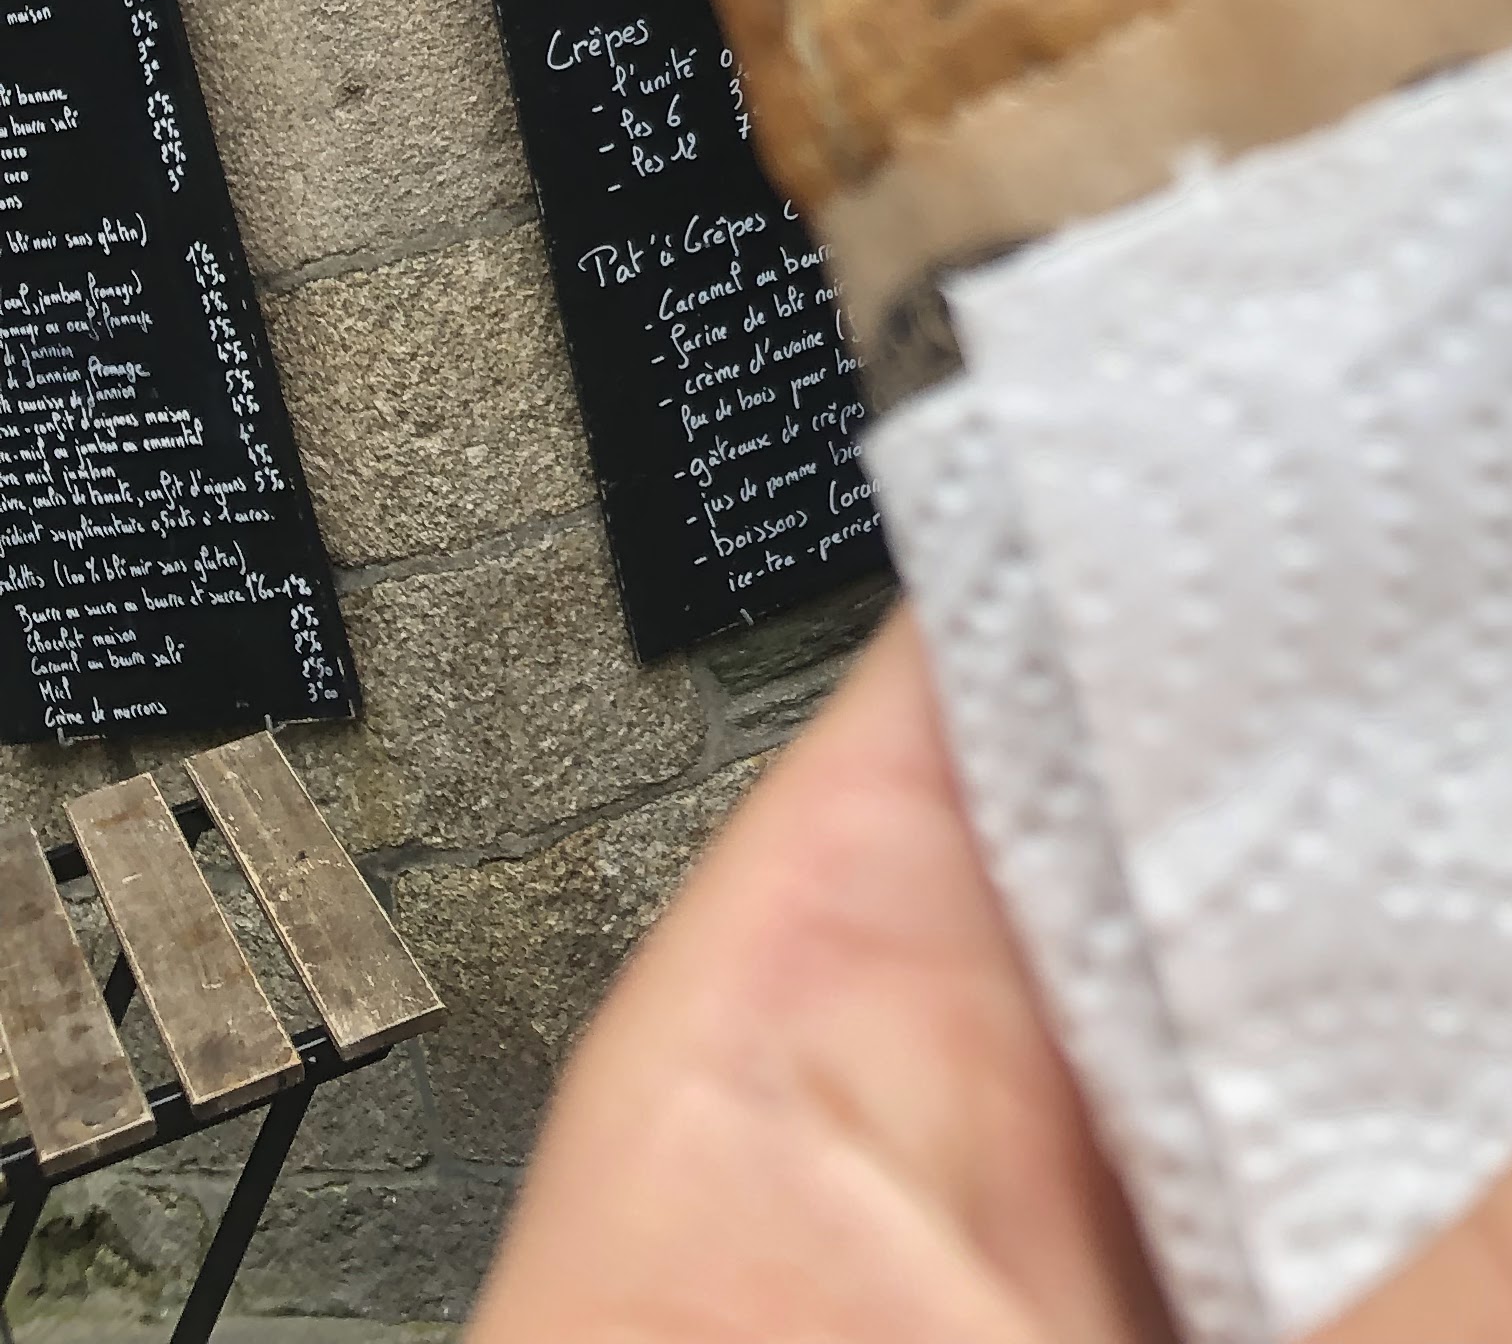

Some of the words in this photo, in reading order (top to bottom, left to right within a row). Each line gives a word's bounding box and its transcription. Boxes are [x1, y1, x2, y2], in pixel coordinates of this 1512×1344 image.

[7, 6, 51, 25] maison
[547, 20, 648, 75] Crêpes
[15, 84, 67, 105] banane
[611, 48, 696, 98] l'unité
[621, 109, 652, 139] les
[667, 94, 680, 126] 6
[632, 146, 663, 176] les
[671, 133, 696, 160] 12
[65, 233, 92, 248] sans
[685, 214, 765, 256] Crêpes
[659, 261, 742, 320] Caramel
[757, 270, 778, 286] au
[670, 324, 728, 370] farine
[744, 306, 765, 332] de
[774, 286, 804, 317] blé
[684, 362, 741, 395] crème
[749, 330, 826, 379] d'avoine
[682, 405, 708, 442] feu
[716, 399, 731, 421] de
[737, 387, 775, 410] bois
[791, 368, 826, 409] pour
[690, 434, 771, 487] gâteaux
[783, 416, 799, 443] de
[813, 403, 864, 434] crêpes
[701, 493, 734, 527] jus
[741, 478, 756, 501] de
[767, 463, 815, 498] pomme
[710, 510, 807, 558] boissons
[39, 676, 71, 702] Miel
